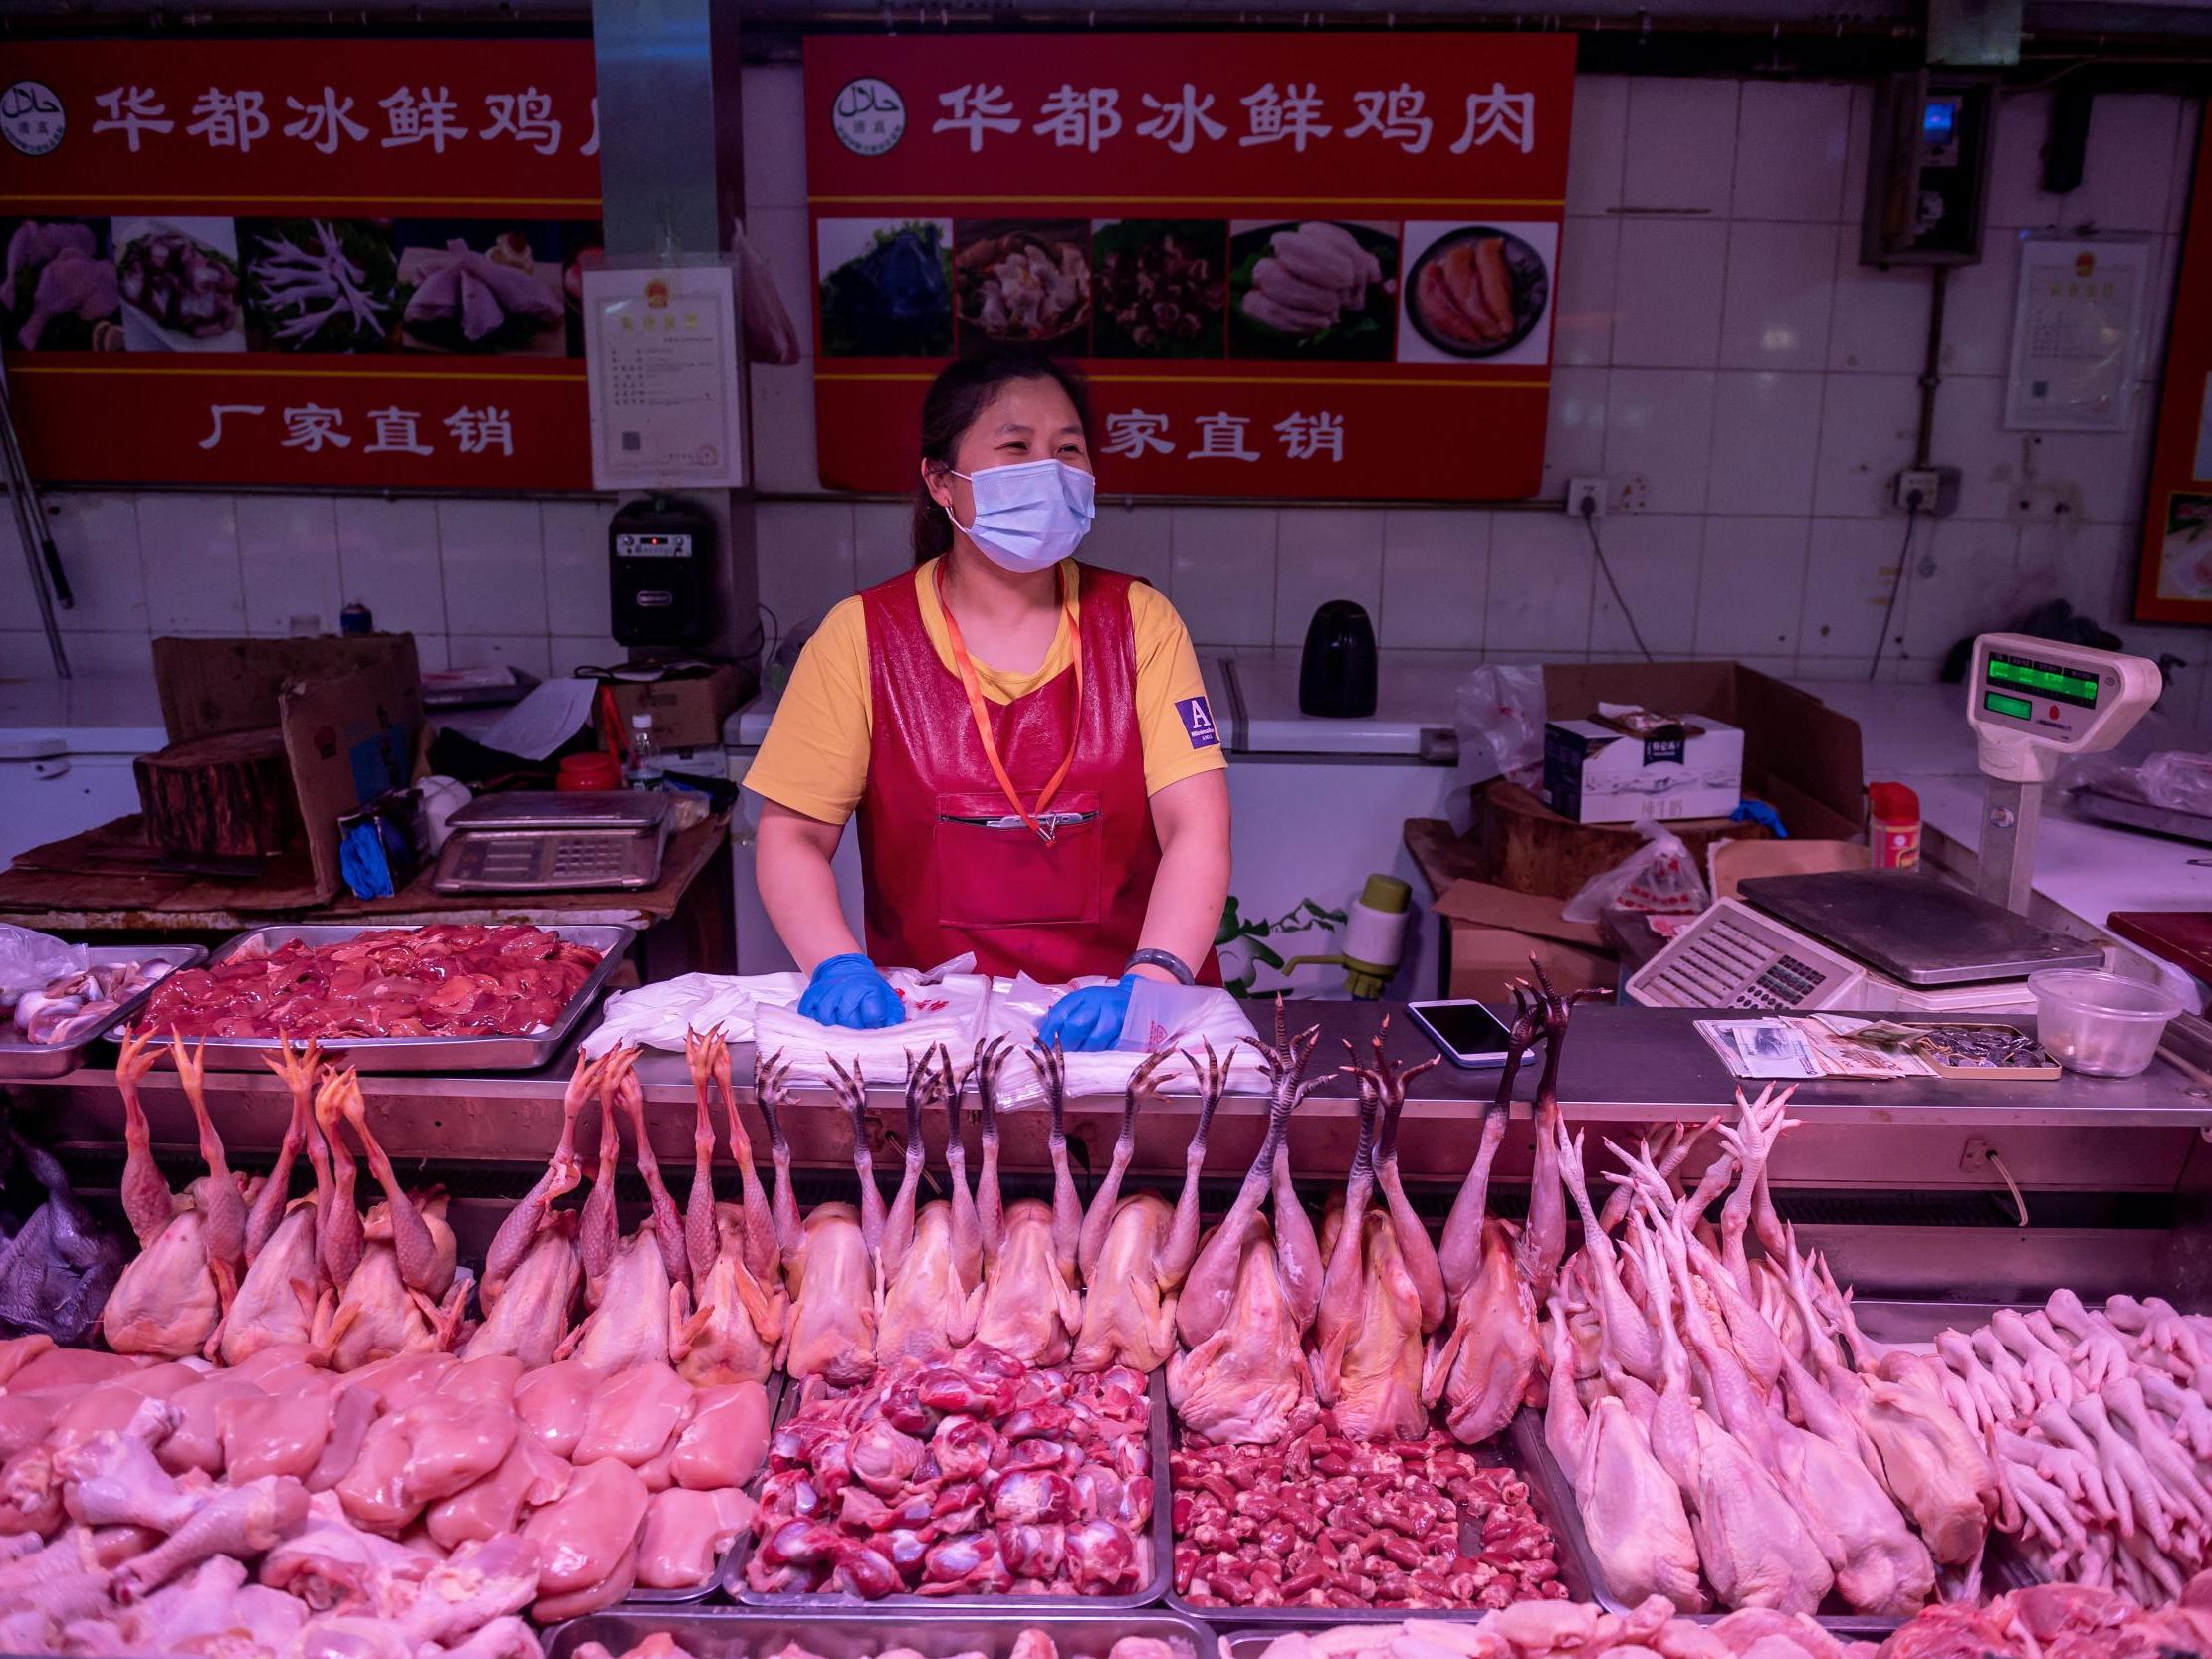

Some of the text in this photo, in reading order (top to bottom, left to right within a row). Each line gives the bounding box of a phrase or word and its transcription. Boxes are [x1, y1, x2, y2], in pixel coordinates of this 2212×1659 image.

[92, 86, 599, 157] 华都冰鲜鸡
[932, 82, 1535, 155] 华都冰鲜鸡肉
[198, 402, 514, 457] 厂家直销
[1100, 407, 1345, 463] 家直销
[1191, 700, 1212, 728] A
